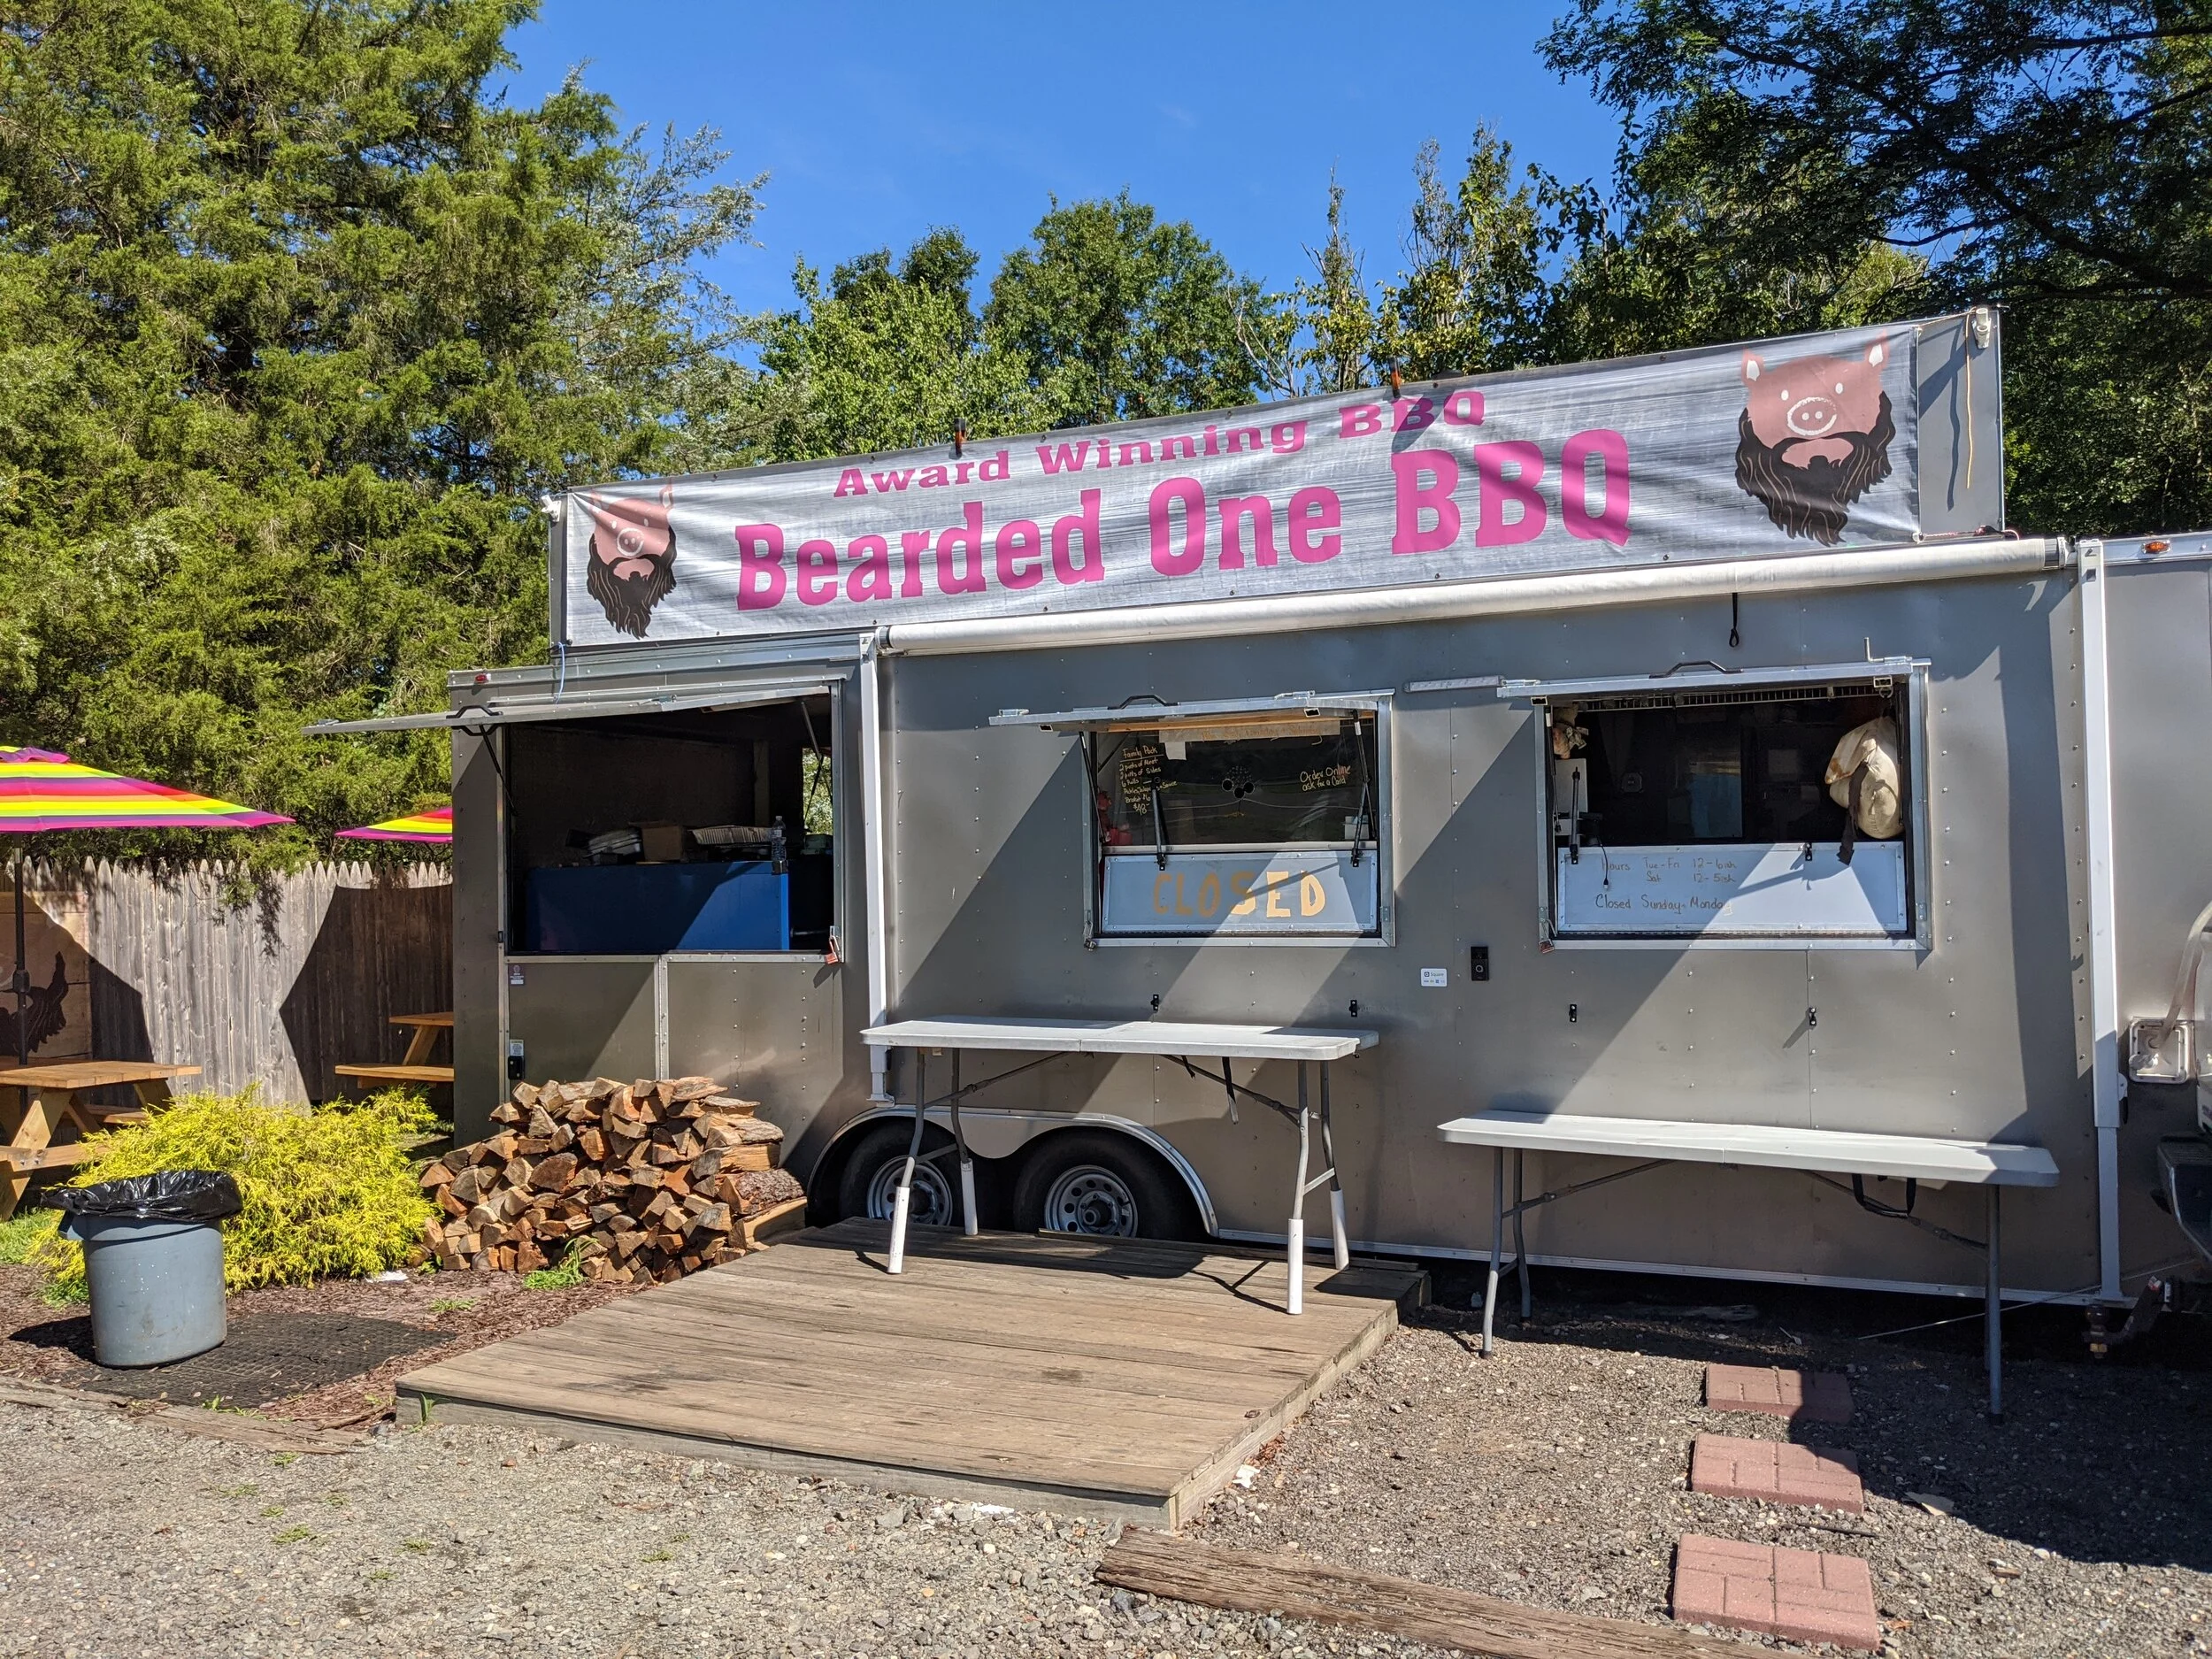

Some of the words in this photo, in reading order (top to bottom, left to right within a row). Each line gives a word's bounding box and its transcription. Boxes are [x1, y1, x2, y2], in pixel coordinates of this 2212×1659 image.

[833, 450, 1010, 497] Award
[1035, 419, 1308, 475] Winning
[1338, 390, 1485, 439] BBQ
[734, 488, 1105, 611] Bearded
[1149, 476, 1341, 576] One
[1391, 428, 1632, 555] BBQ
[1122, 747, 1143, 758] Family
[1300, 769, 1324, 783] Order
[1325, 764, 1351, 777] Online
[1331, 775, 1347, 786] Card
[1647, 870, 1662, 882] Sat
[1153, 871, 1325, 918] CLOSED
[1595, 894, 1632, 909] Closed
